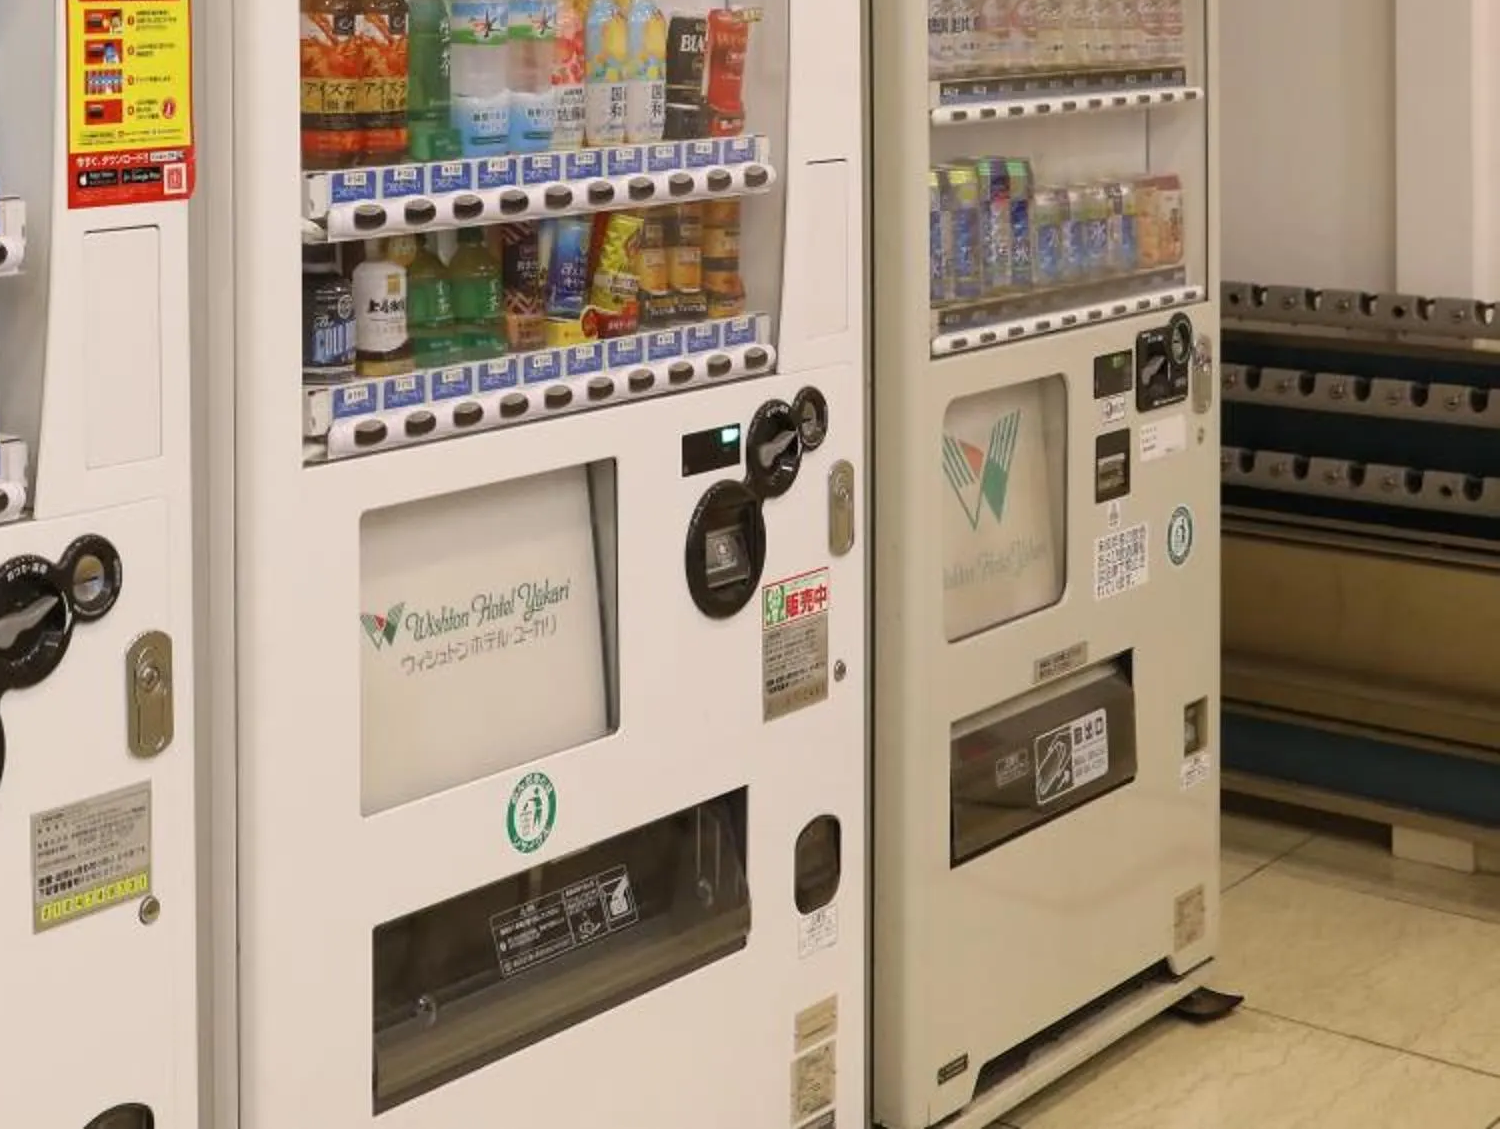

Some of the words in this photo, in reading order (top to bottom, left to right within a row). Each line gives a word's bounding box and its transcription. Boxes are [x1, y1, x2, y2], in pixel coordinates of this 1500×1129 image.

[680, 34, 706, 52] BLA
[405, 606, 471, 641] Wishton
[471, 586, 517, 628] Hotel
[785, 583, 827, 617] 販売中
